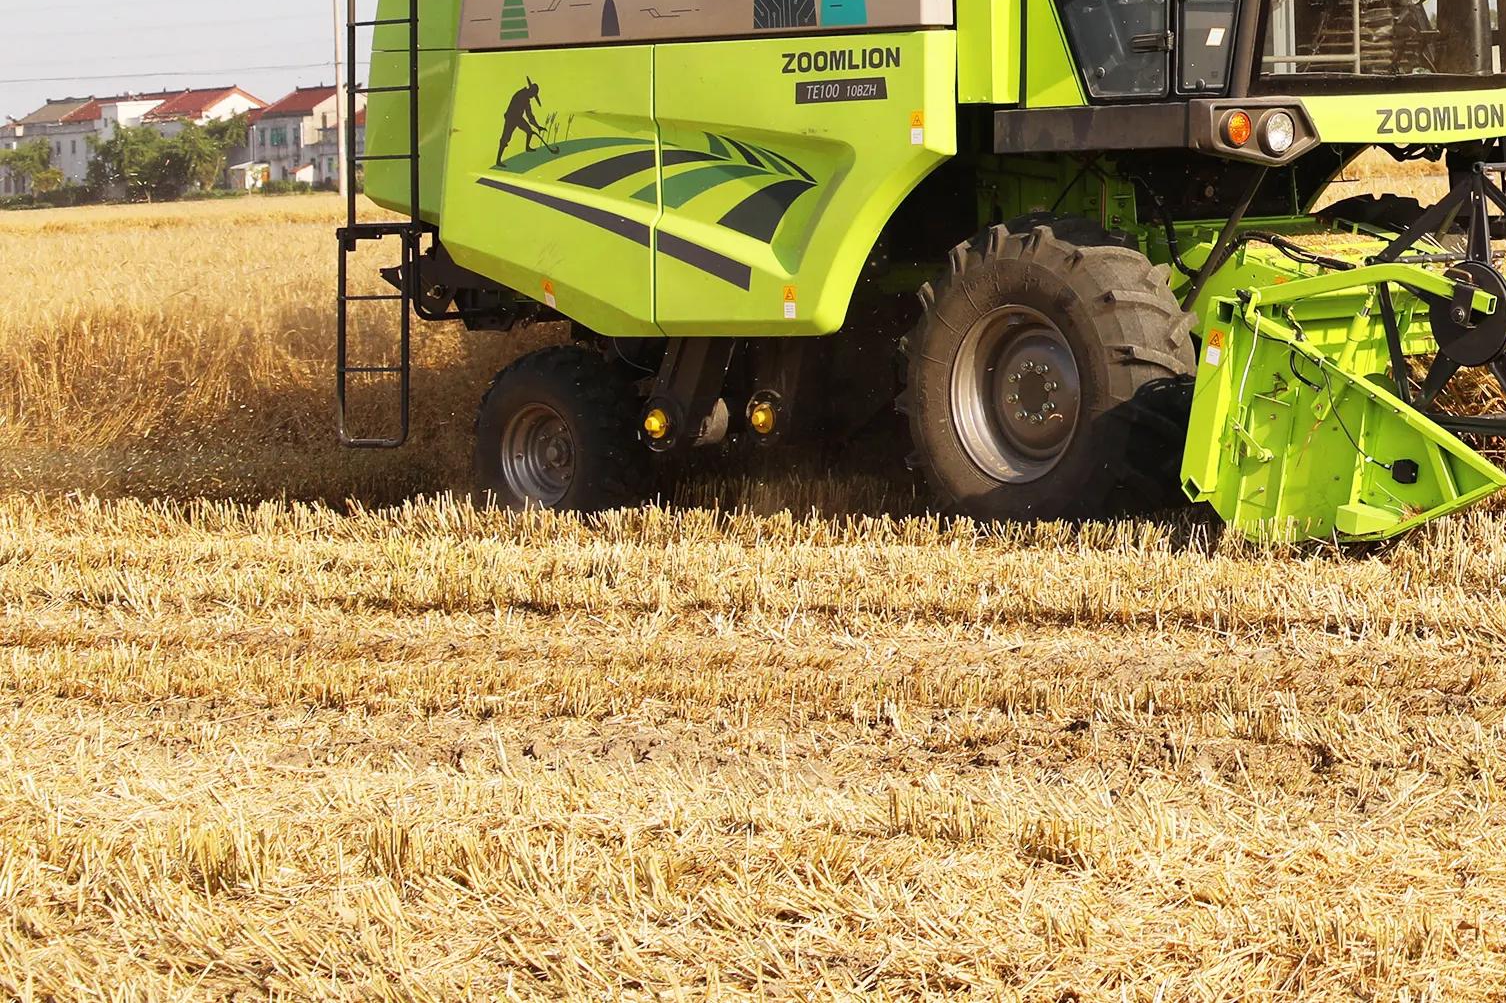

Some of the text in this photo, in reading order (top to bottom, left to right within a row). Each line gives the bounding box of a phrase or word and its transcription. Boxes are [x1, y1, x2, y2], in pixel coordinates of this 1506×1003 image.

[781, 46, 901, 74] ZOOMLION
[806, 83, 878, 100] TE100 10BZH
[1376, 103, 1504, 134] ZOOMLION
